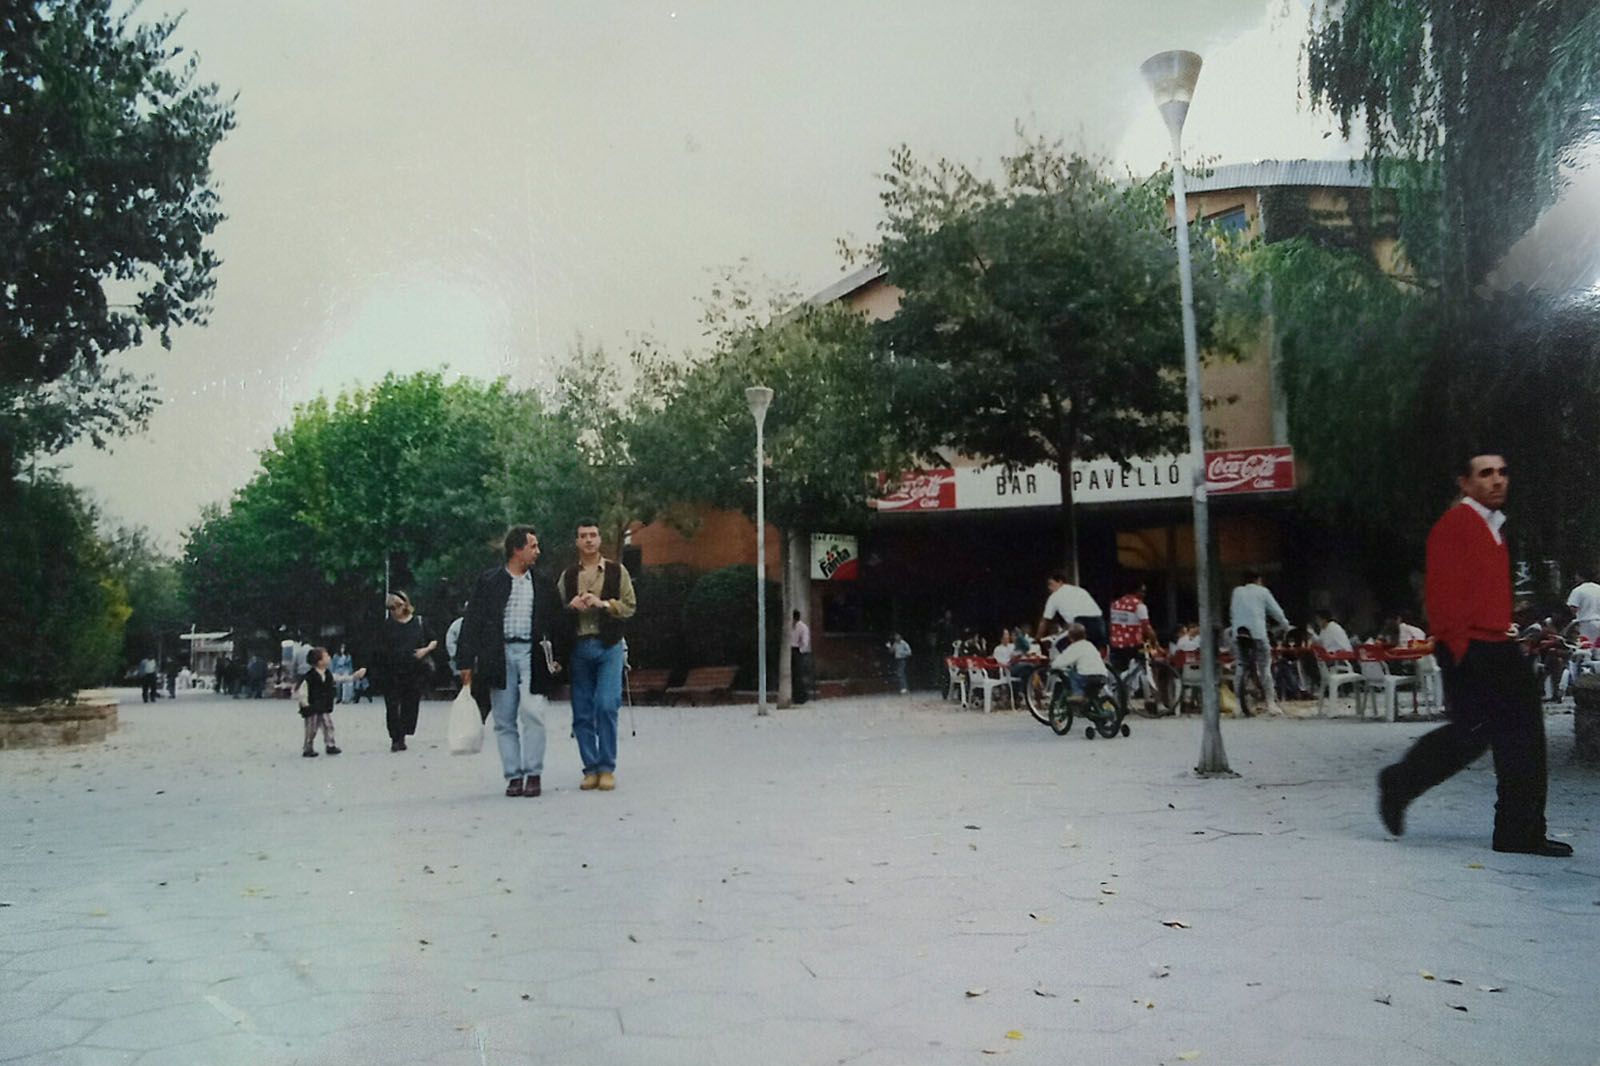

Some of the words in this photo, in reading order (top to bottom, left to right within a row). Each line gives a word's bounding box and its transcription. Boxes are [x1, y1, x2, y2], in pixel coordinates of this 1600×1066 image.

[996, 474, 1037, 496] BAR
[1072, 460, 1180, 491] PAVELLÓ
[819, 548, 851, 578] Fanta
